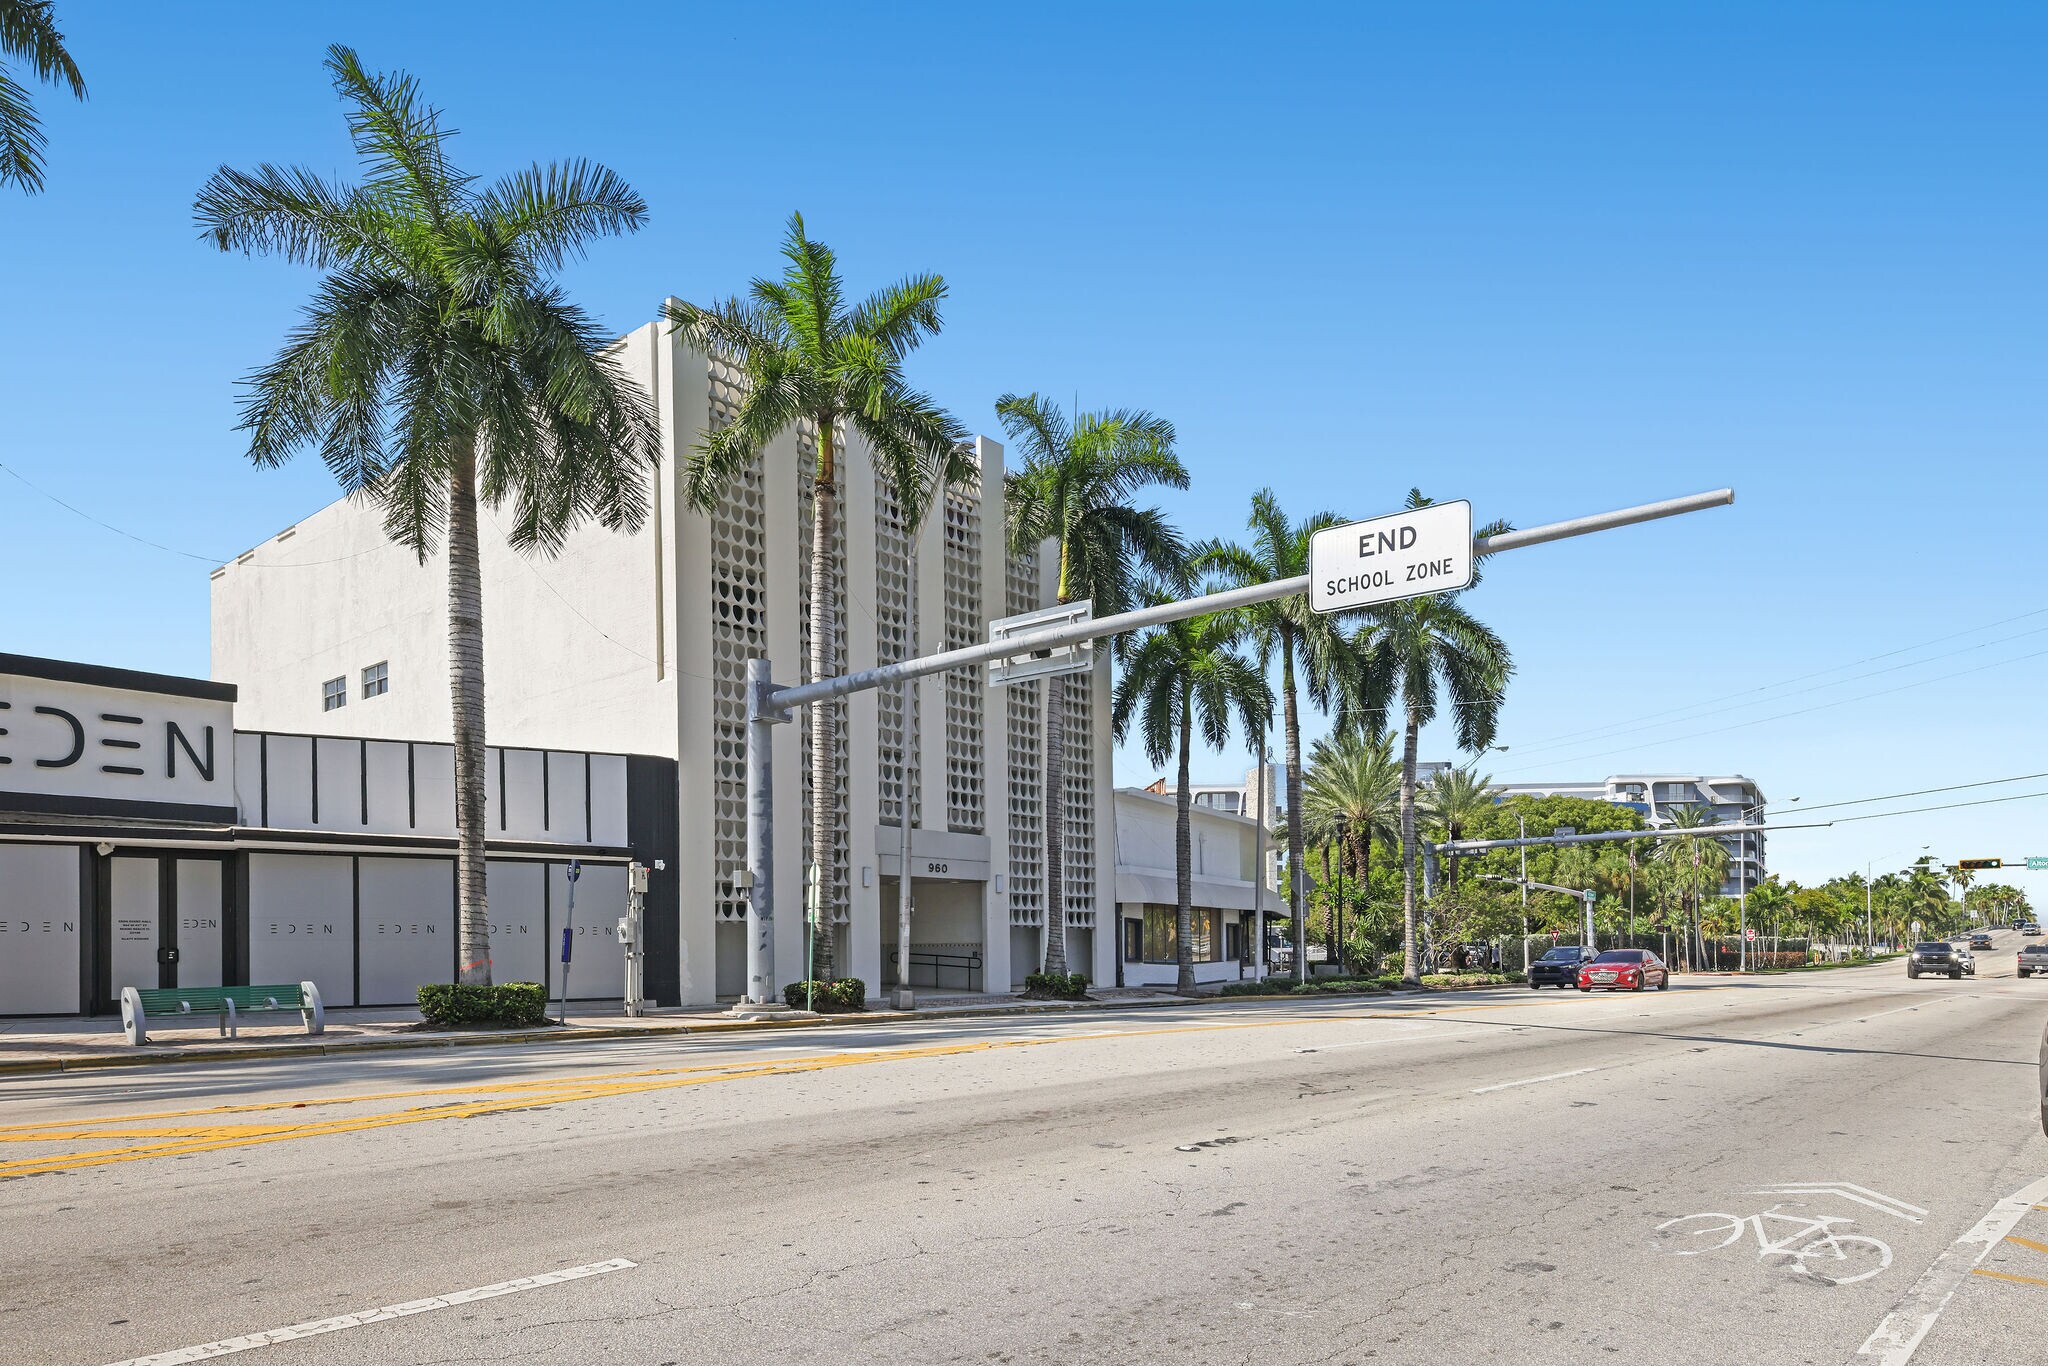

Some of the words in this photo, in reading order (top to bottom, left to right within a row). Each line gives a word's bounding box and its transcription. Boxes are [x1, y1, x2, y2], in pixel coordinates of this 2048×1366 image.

[1359, 526, 1418, 558] END
[1326, 570, 1394, 596] SCHOOL
[1406, 557, 1453, 581] ZONE
[0, 701, 215, 782] DEN
[928, 862, 948, 873] 960
[0, 921, 74, 933] EDEN
[183, 918, 217, 929] EDEN
[270, 923, 333, 934] EDEN
[378, 924, 435, 934] EDEN
[490, 924, 528, 935] DEN
[578, 926, 613, 936] DEN
